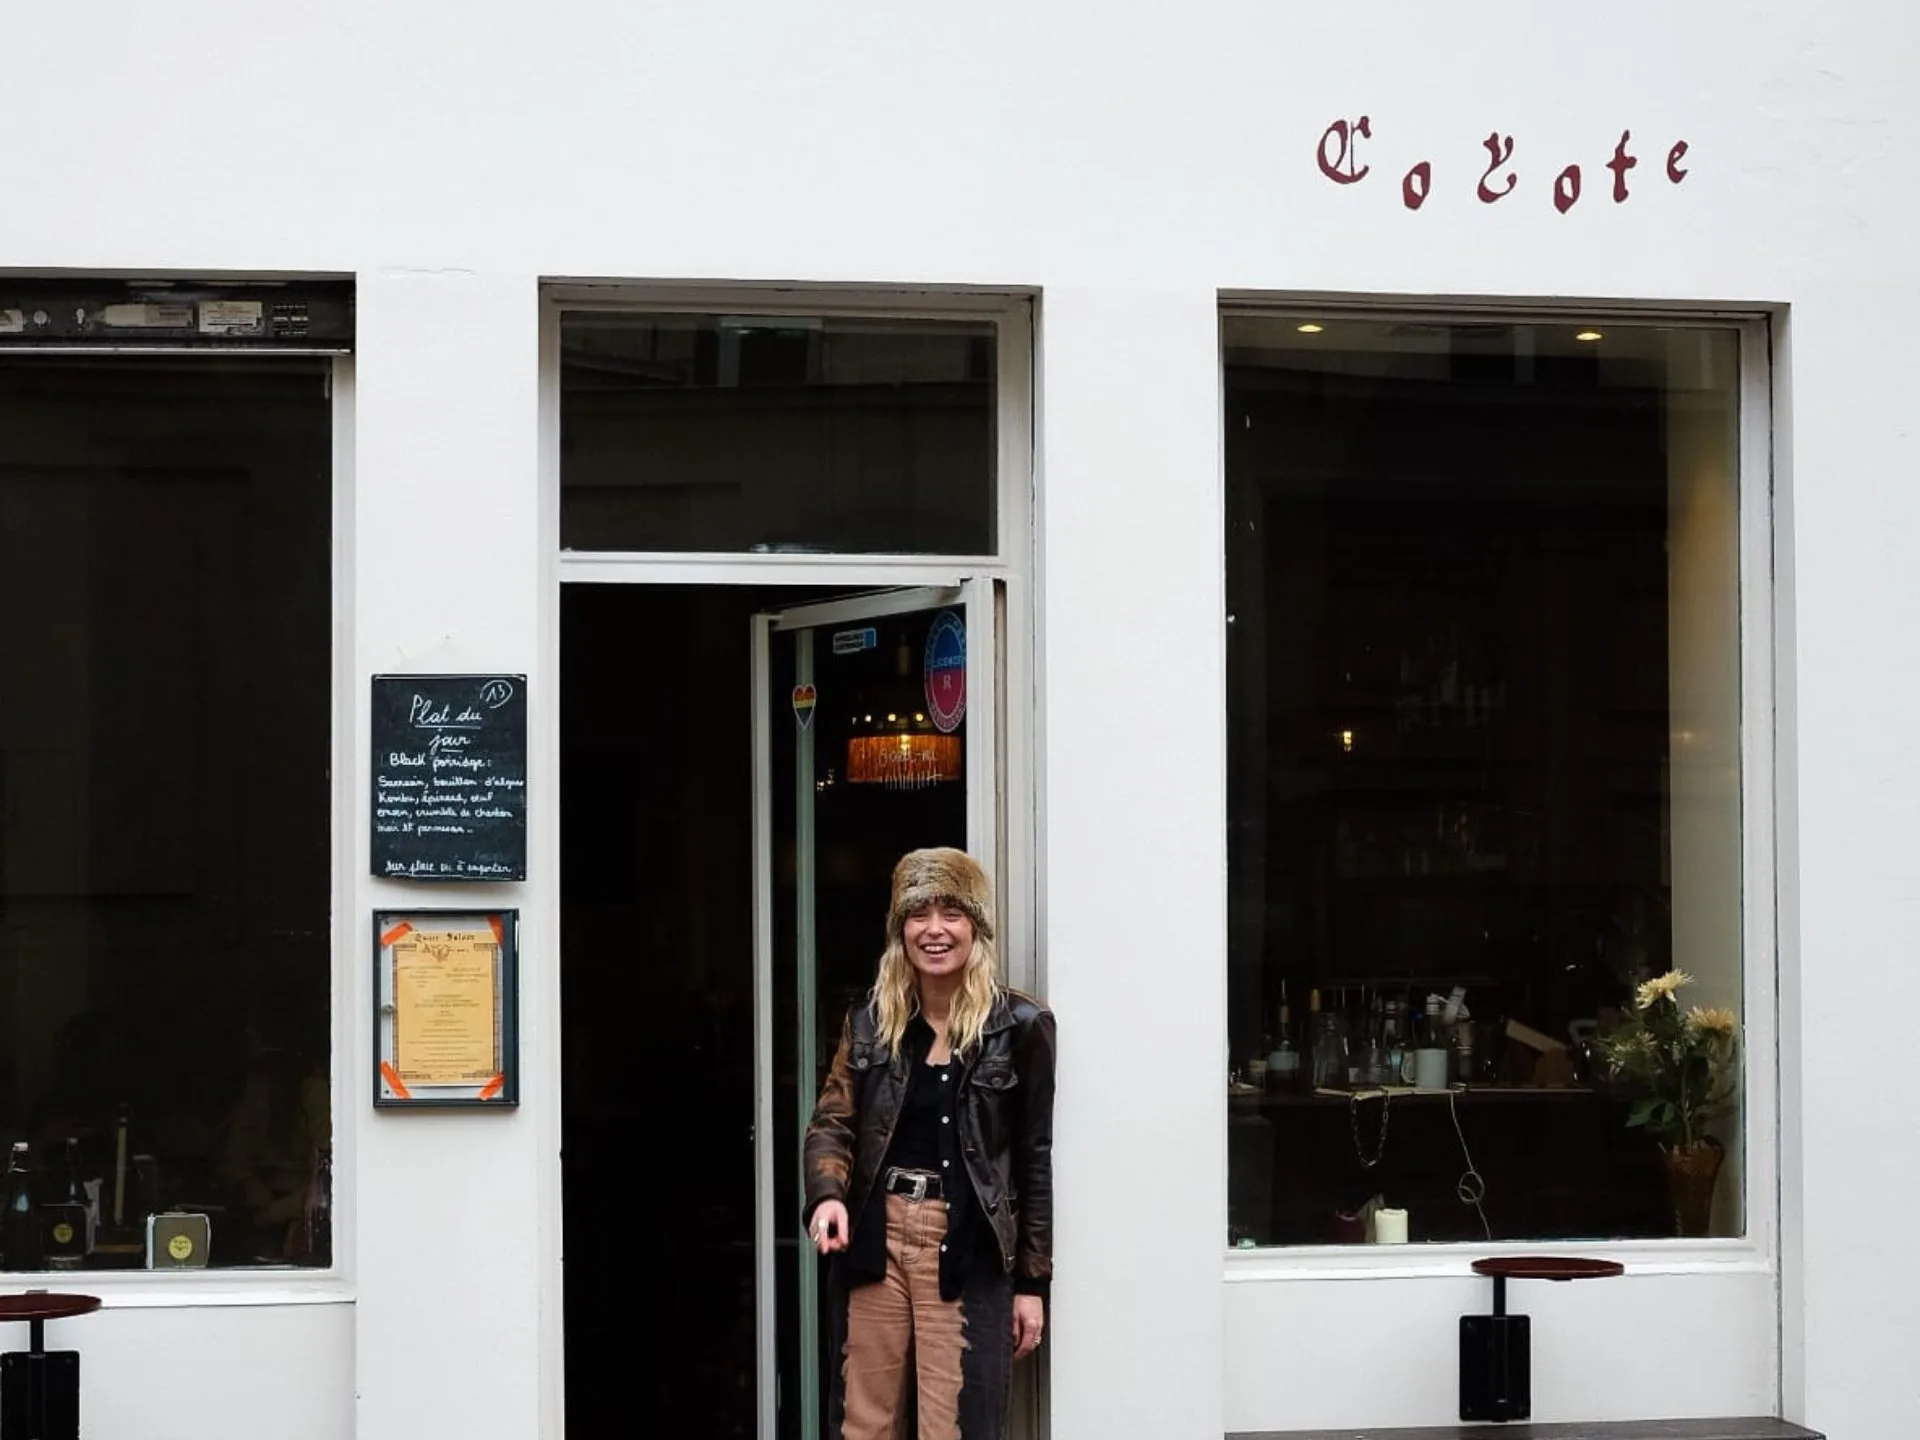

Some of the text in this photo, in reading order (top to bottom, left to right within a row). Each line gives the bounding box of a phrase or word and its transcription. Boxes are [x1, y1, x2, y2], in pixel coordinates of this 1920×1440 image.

[410, 694, 483, 725] Plat du
[428, 728, 471, 755] jour
[389, 752, 426, 766] Black
